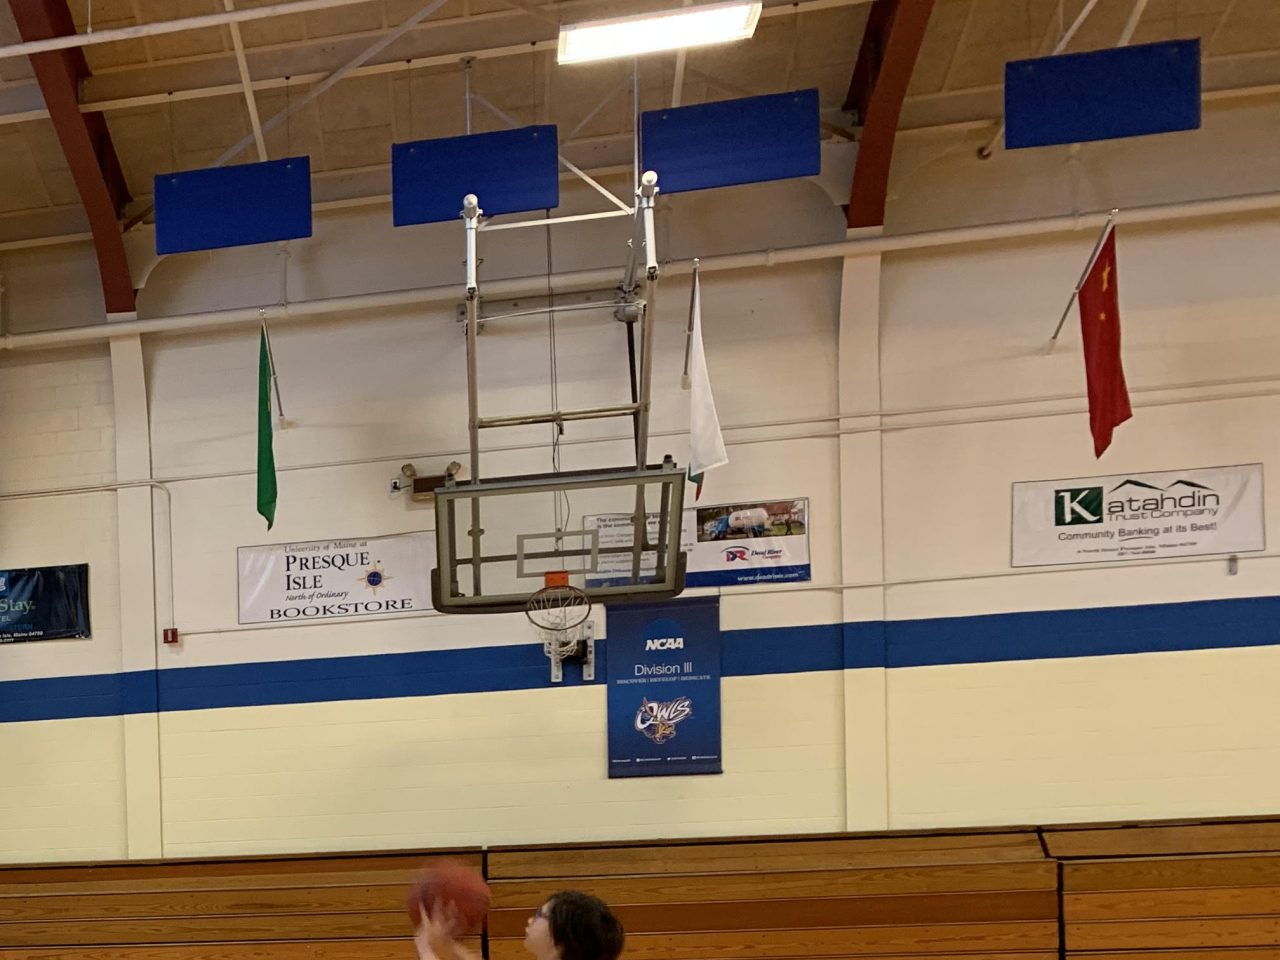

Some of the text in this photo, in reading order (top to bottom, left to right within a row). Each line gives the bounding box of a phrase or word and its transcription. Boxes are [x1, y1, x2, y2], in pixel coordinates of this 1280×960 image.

[1106, 507, 1219, 522] Trust Company
[1058, 522, 1217, 541] Community Banking at its Best!
[284, 544, 320, 554] University
[333, 541, 357, 549] Maine
[285, 551, 370, 572] PRESQUE
[285, 574, 323, 591] ISLE
[285, 590, 349, 603] North of Ordinary
[270, 598, 413, 620] BOOKSTORE
[645, 637, 684, 651] NCAA
[634, 662, 693, 676] Division III
